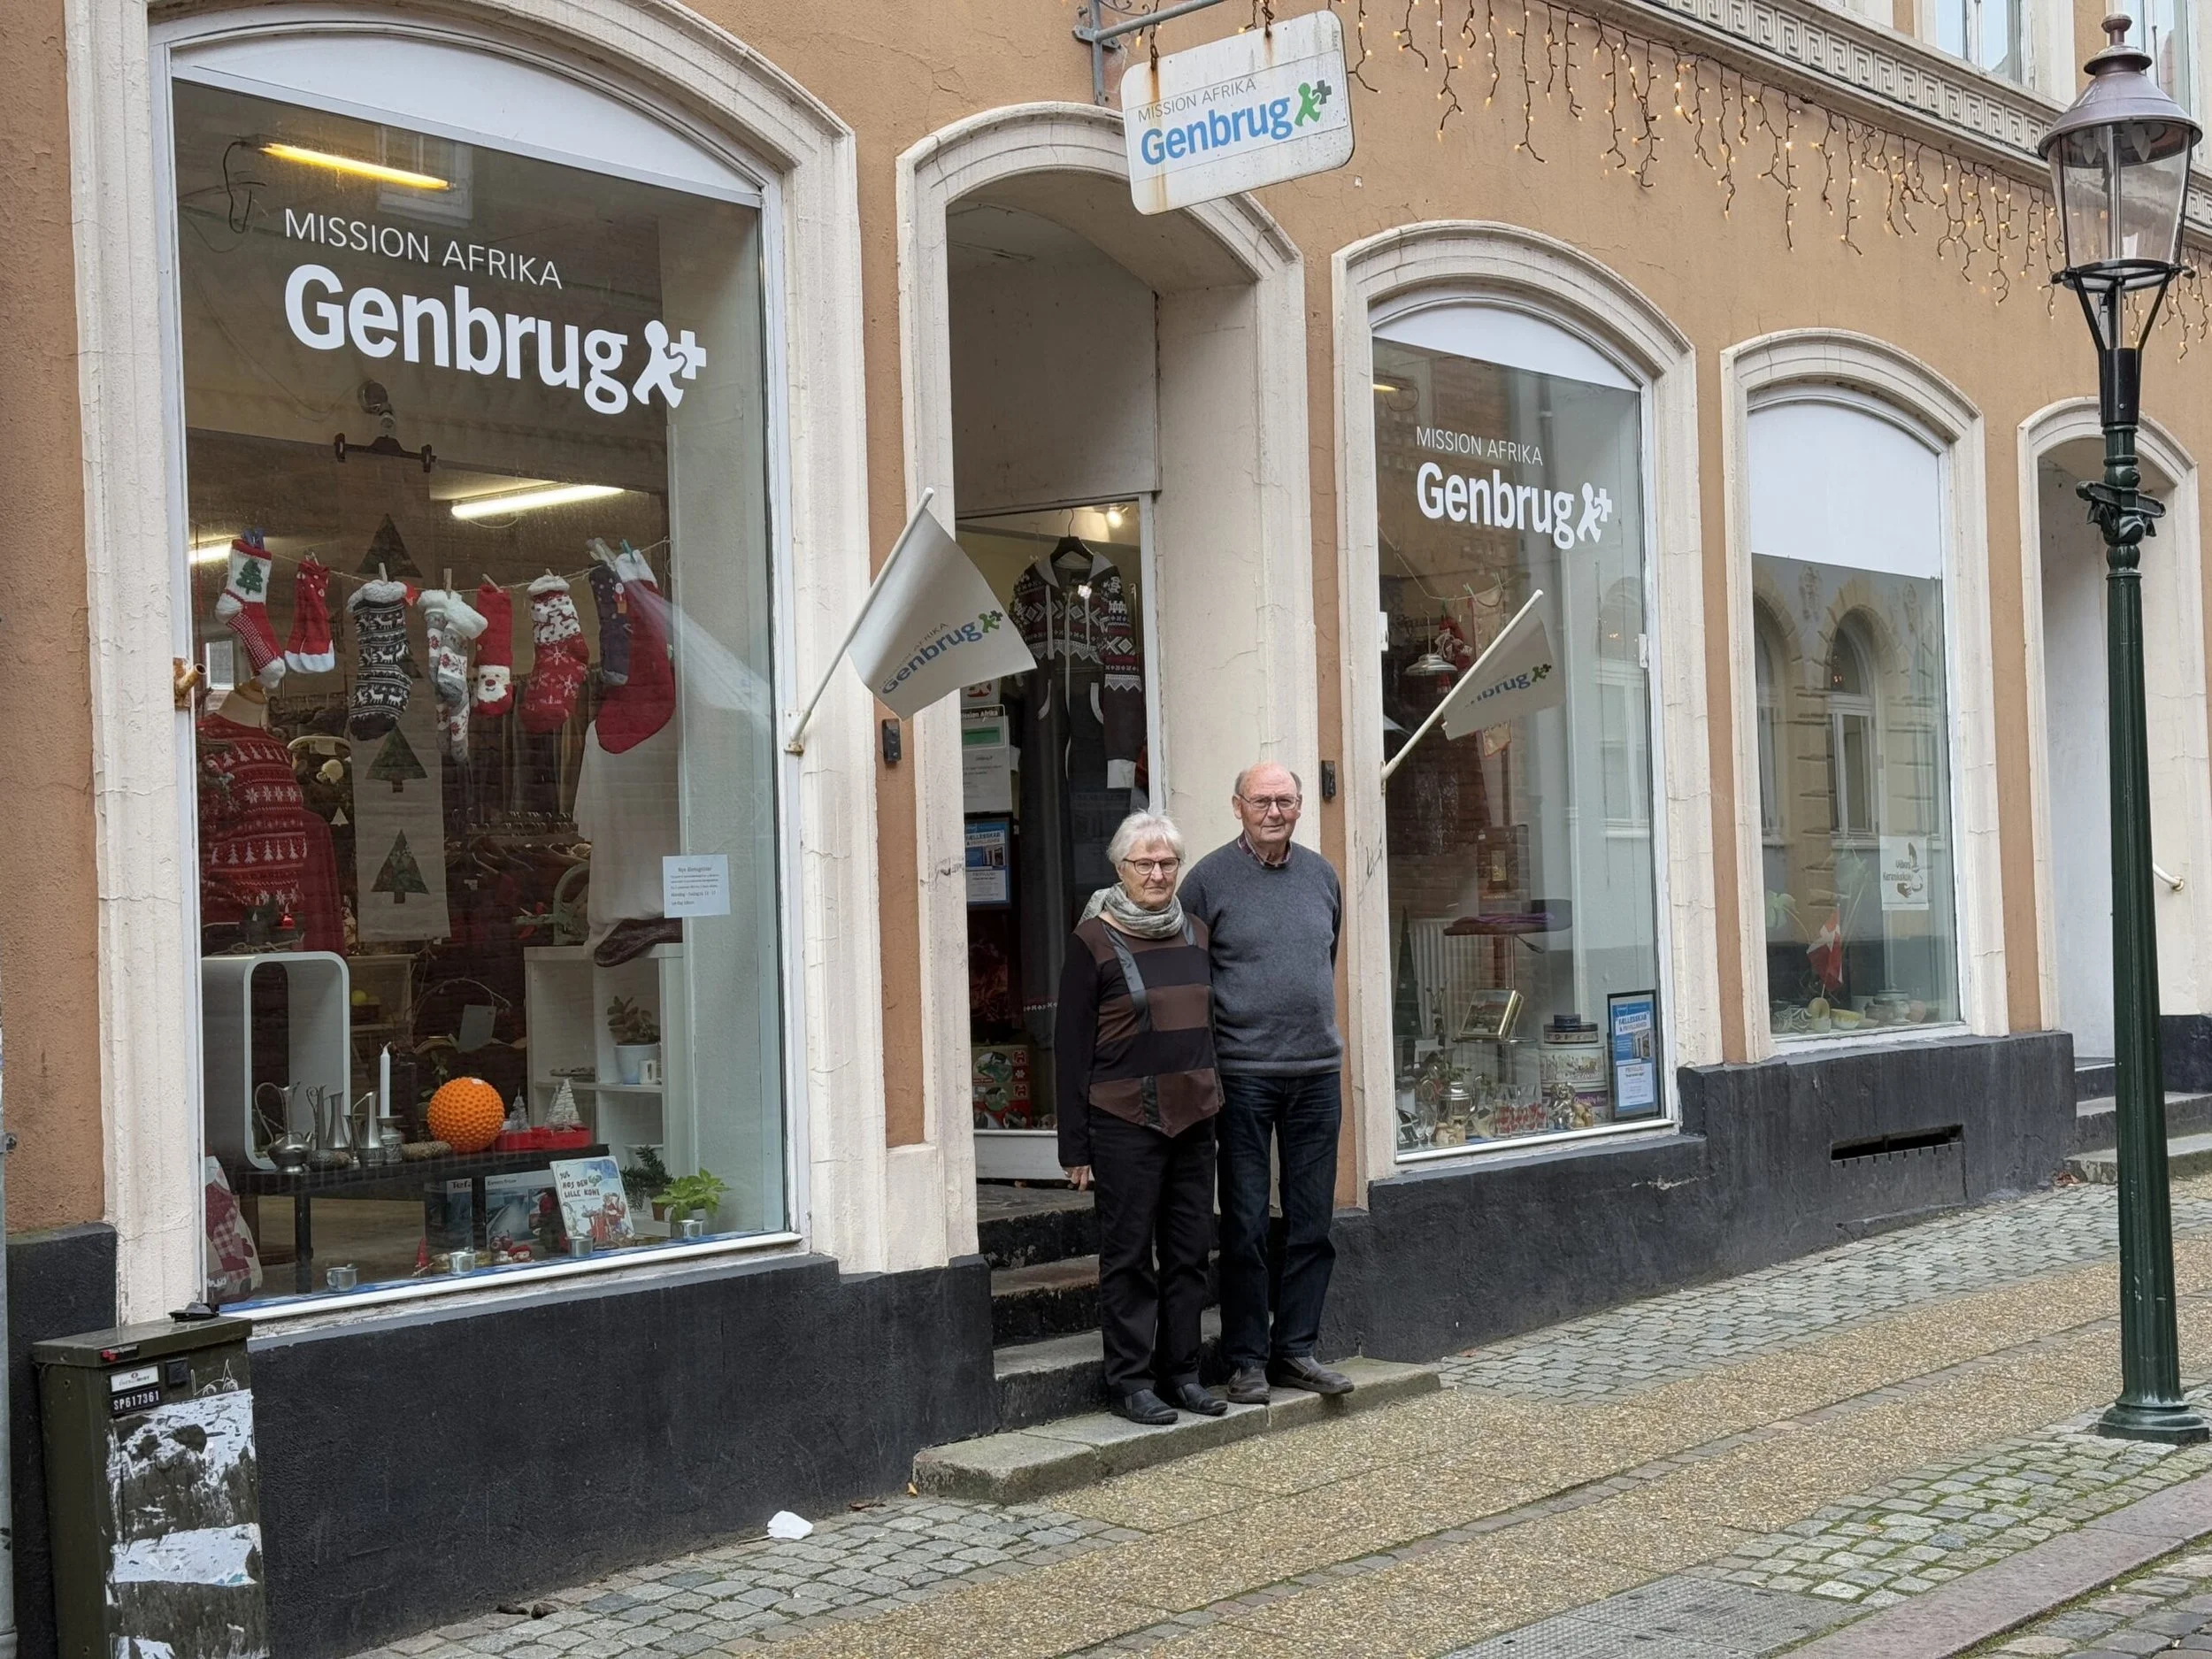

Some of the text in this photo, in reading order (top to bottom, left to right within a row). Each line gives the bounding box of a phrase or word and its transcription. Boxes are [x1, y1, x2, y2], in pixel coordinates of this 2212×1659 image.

[1138, 78, 1256, 124] MISSION AFRIKA
[1141, 96, 1294, 166] Genbrug
[284, 208, 563, 290] MISSION AFRIKA
[284, 264, 629, 415] Genbrug
[1416, 426, 1544, 466] MISSION AFRIKA
[1416, 461, 1576, 550] Genbrug
[880, 621, 983, 695] Genbrug
[576, 1179, 588, 1187] DEN
[113, 1390, 159, 1411] SP617361
